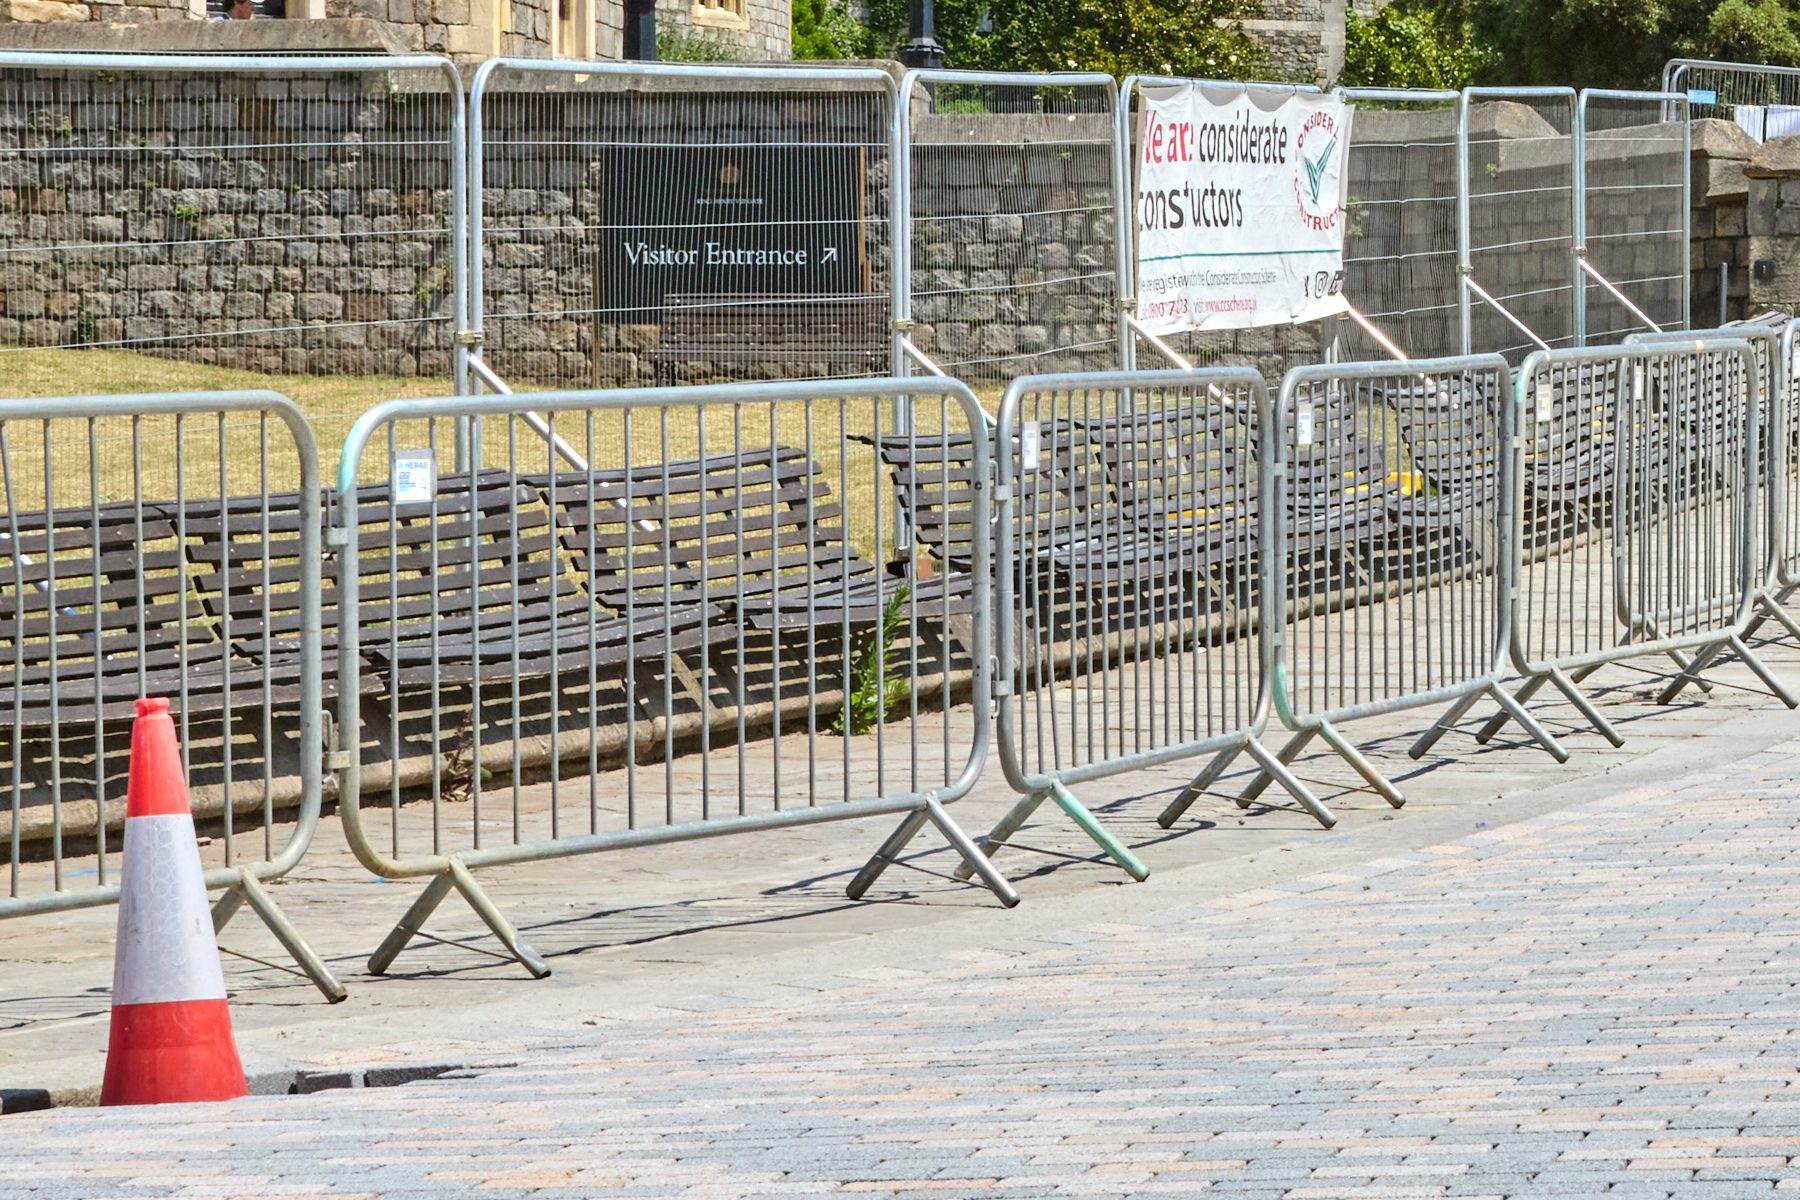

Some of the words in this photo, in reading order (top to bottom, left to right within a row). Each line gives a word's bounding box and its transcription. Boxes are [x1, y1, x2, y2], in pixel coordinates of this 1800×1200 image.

[1199, 108, 1288, 164] considerate
[623, 242, 698, 265] Visitor
[706, 242, 807, 265] Entrance
[405, 461, 428, 469] HERAS
